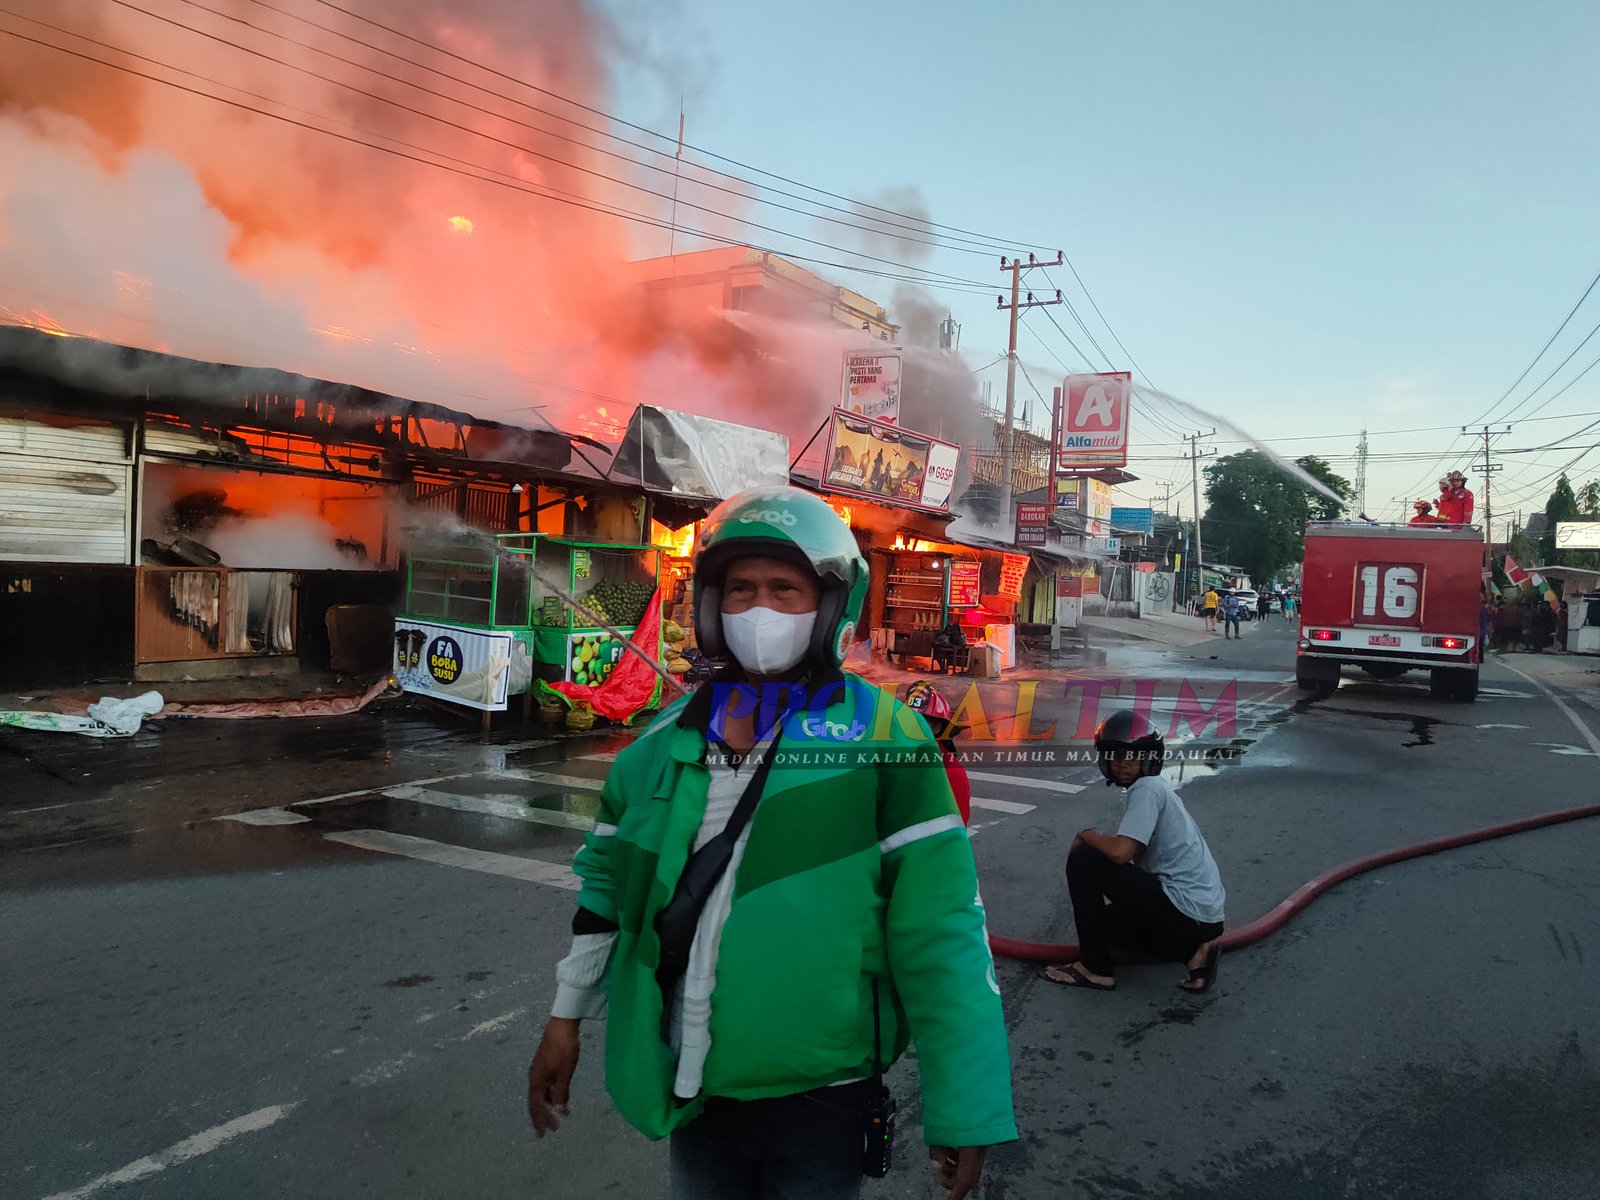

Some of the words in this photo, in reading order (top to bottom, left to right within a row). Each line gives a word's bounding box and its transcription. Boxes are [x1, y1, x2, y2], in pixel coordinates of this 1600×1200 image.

[850, 357, 874, 366] KARENA
[850, 367, 867, 376] PASTI
[867, 367, 883, 375] YANG
[850, 375, 877, 384] PERTAMA
[1066, 435, 1120, 447] Alfamidi
[935, 466, 954, 482] GGSP
[1361, 566, 1418, 618] 16
[437, 640, 453, 658] FA
[431, 655, 458, 671] BOBA
[603, 664, 611, 673] ES
[433, 668, 454, 680] SUSU
[802, 717, 867, 742] Grab
